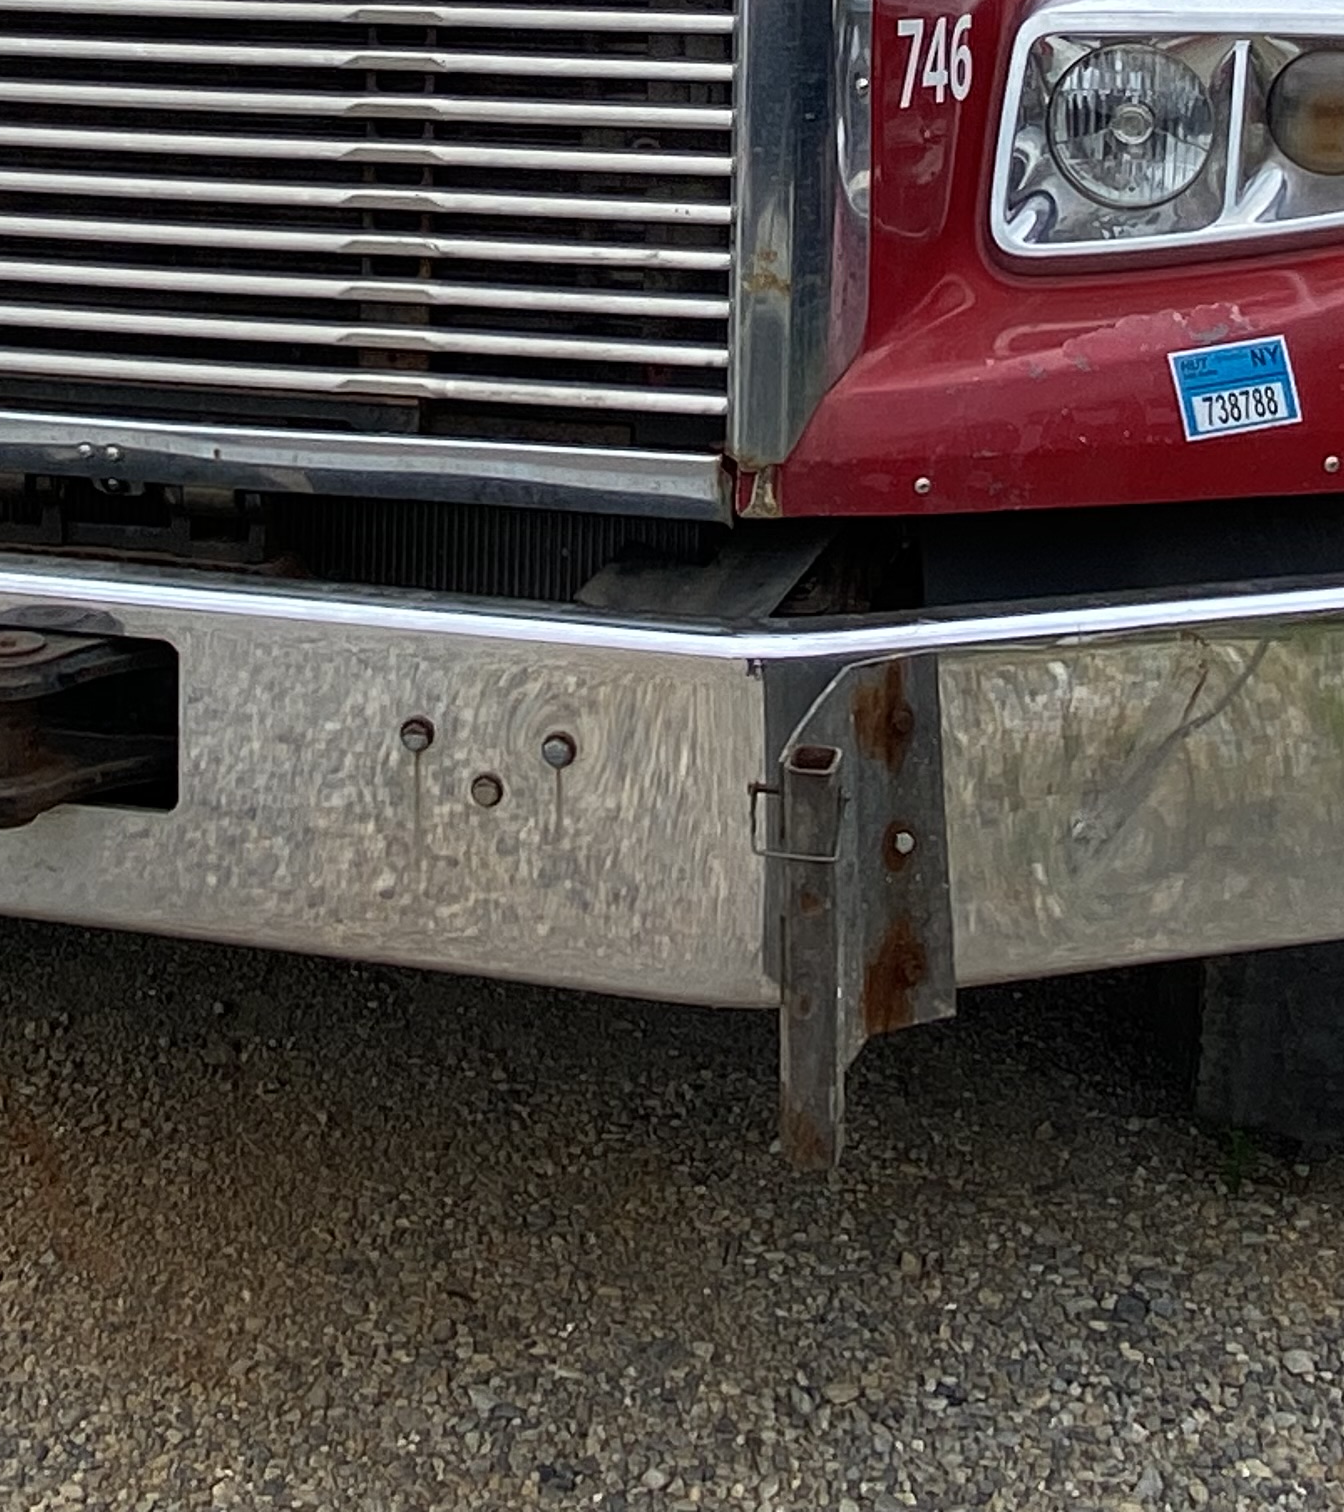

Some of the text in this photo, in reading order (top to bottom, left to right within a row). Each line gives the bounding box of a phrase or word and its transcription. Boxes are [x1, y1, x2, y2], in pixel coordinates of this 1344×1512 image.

[897, 13, 973, 109] 746
[1250, 344, 1279, 368] NY
[1202, 386, 1279, 426] 738788
